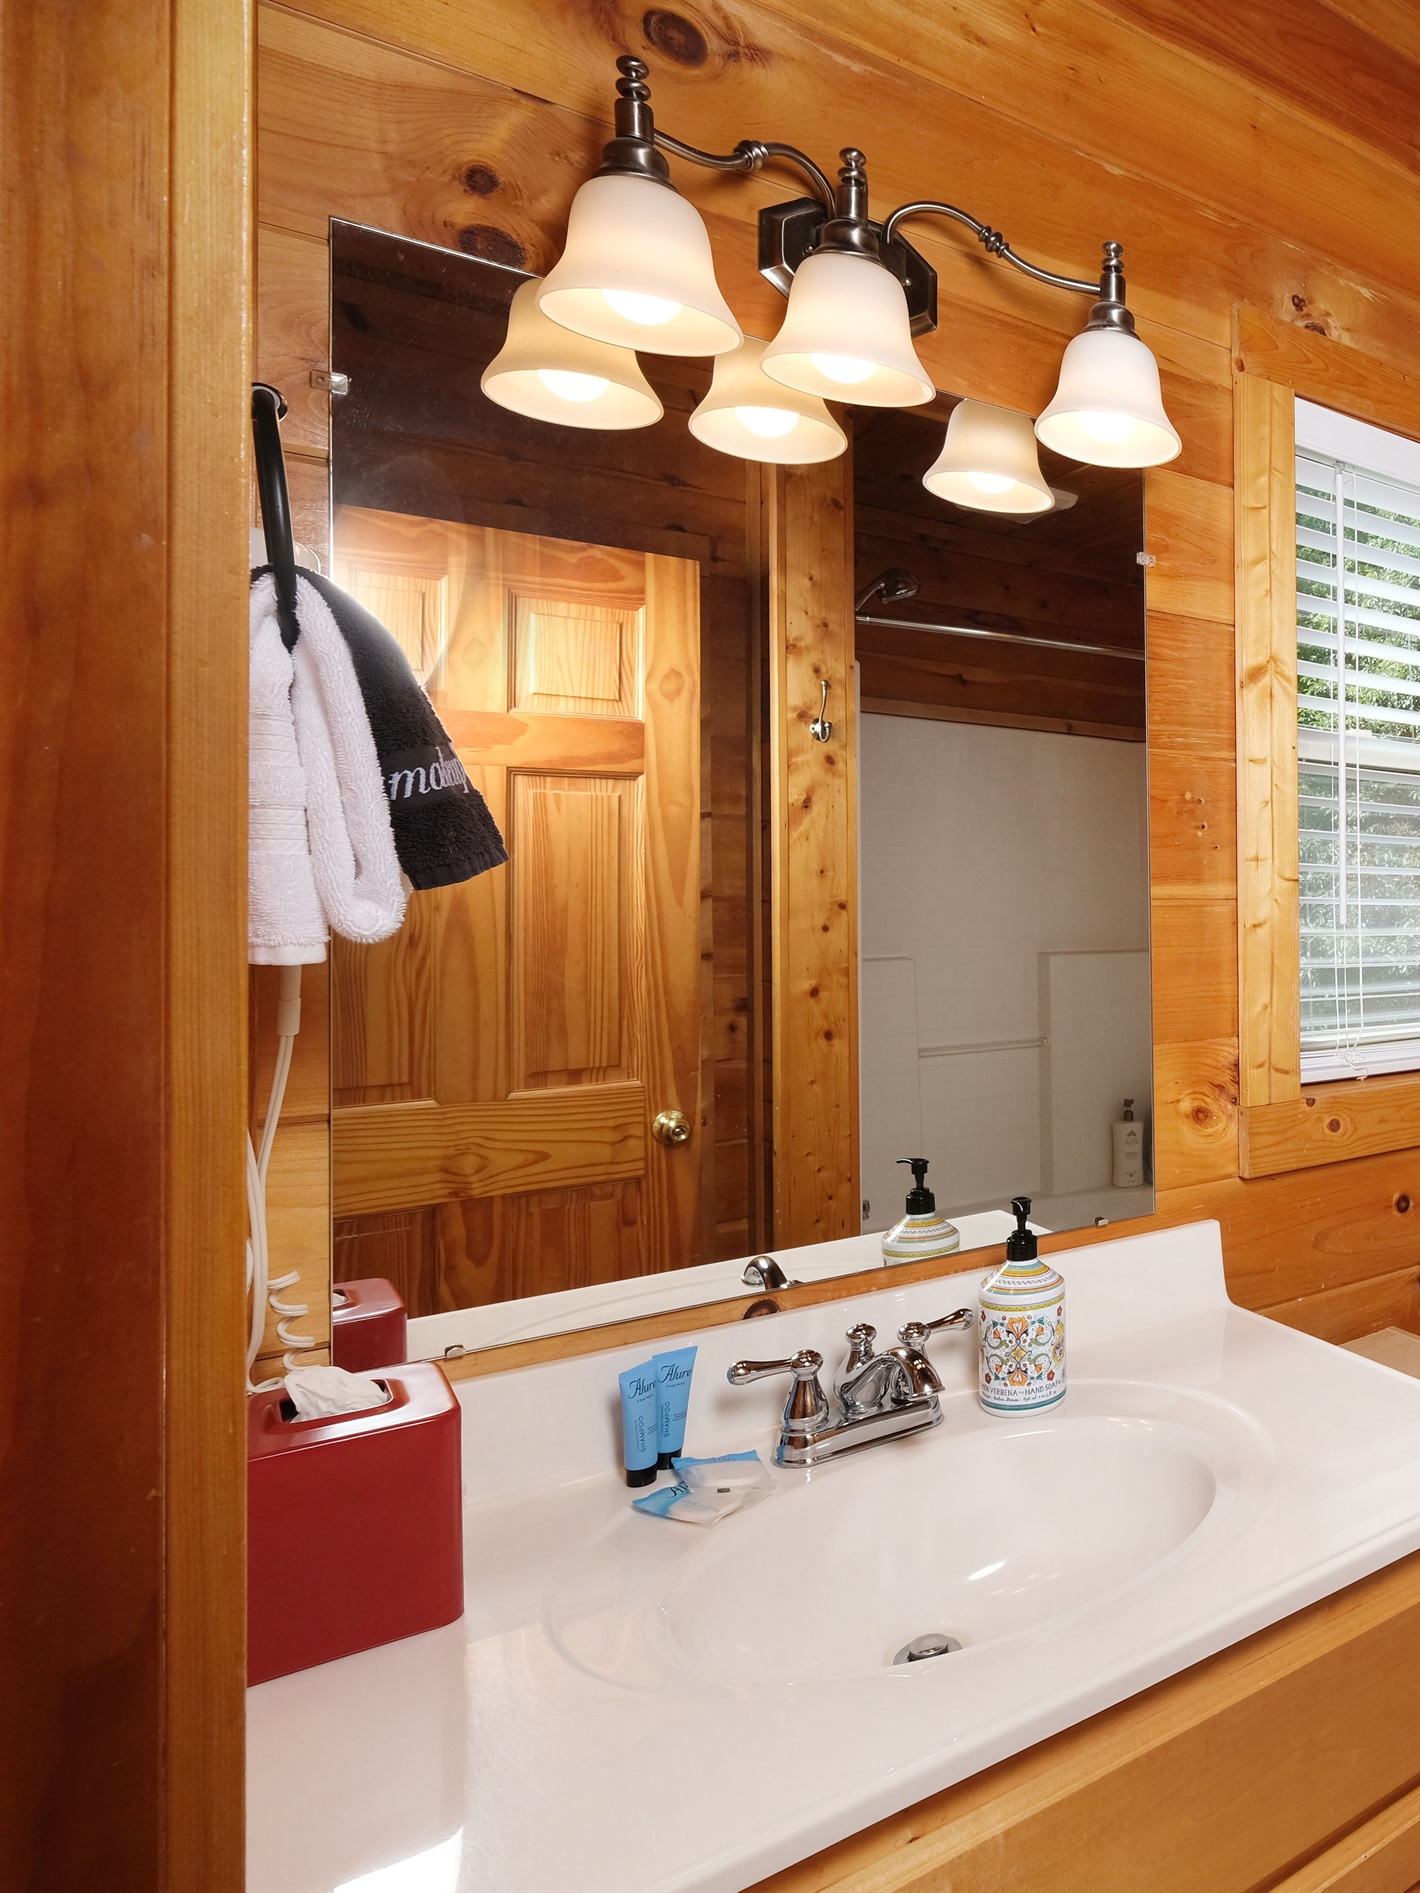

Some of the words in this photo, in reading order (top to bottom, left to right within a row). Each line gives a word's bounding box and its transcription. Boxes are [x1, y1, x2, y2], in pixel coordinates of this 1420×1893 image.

[658, 1364, 692, 1383] Alure
[990, 1387, 1018, 1397] VERBENA
[1025, 1386, 1044, 1396] HAND
[638, 1416, 646, 1452] SHAMPOO
